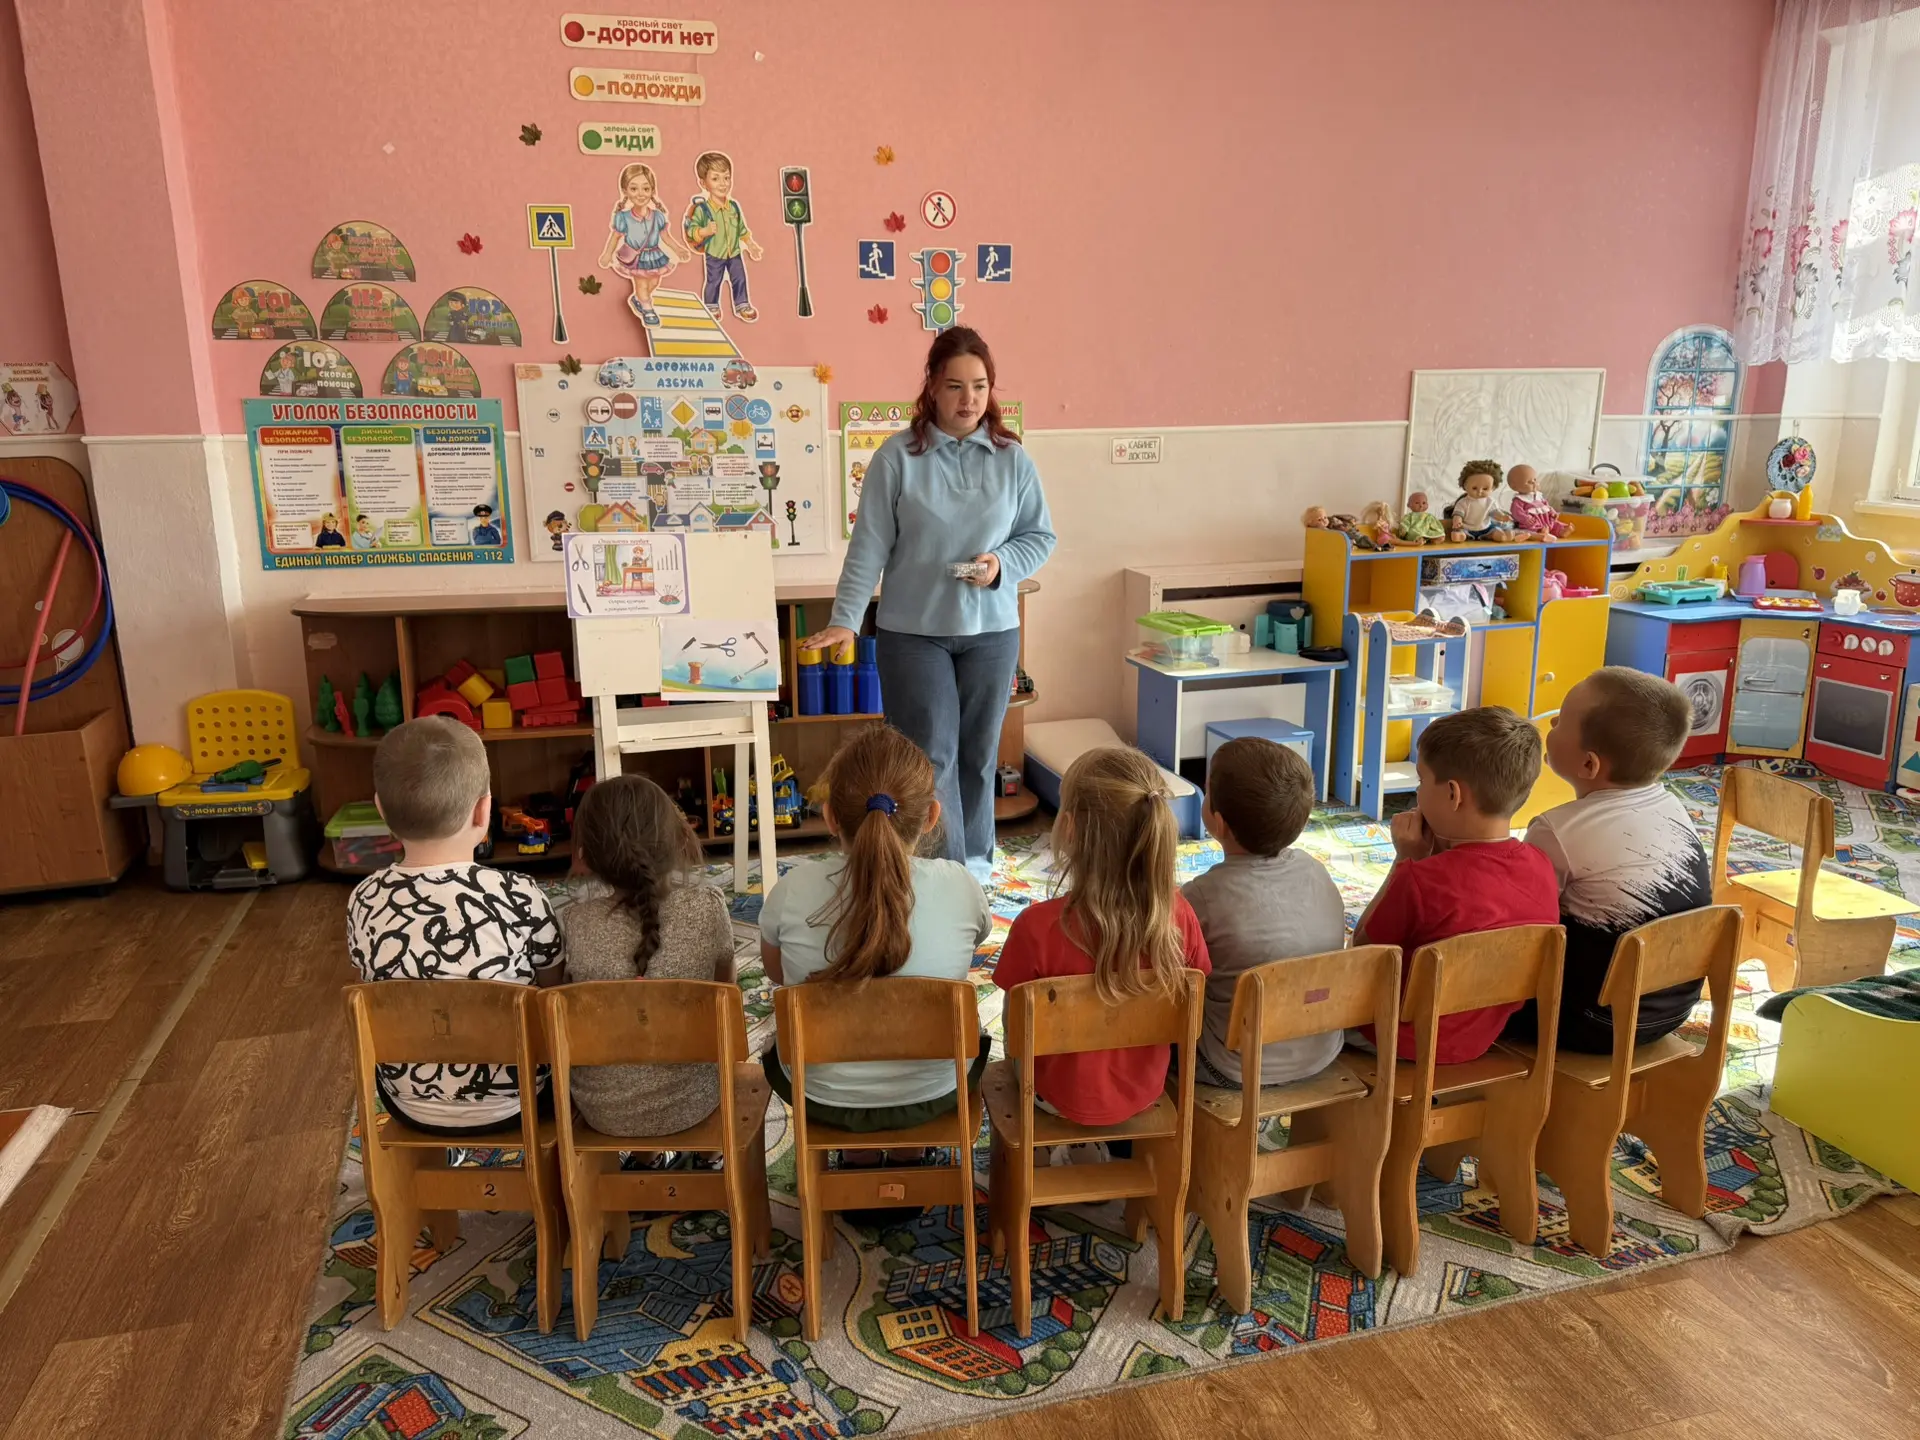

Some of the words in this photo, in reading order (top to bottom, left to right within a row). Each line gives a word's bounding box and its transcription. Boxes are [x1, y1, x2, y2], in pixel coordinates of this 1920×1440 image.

[617, 19, 658, 28] красный
[680, 31, 715, 46] нет
[623, 72, 661, 81] желтый
[258, 291, 291, 309] 101
[350, 287, 383, 307] 112
[469, 298, 502, 316] 102
[303, 351, 338, 369] 103
[644, 361, 715, 372] ДОРОЖНАЯ
[317, 380, 356, 389] ПОМОЩЬ
[657, 377, 704, 388] АЗБУКА
[272, 403, 340, 420] УГОЛОК
[345, 403, 479, 420] БЕЗОПАСНОСТИ
[449, 435, 479, 443] ДОРОГЕ
[1128, 440, 1157, 449] КАБИНЕТ
[1128, 452, 1157, 461] ДОКТОРА
[275, 554, 322, 568] ЕДИНЫЙ
[325, 554, 363, 566] НОМЕР
[367, 551, 416, 565] СЛУЖБЫ
[419, 551, 474, 563] СПАСЕНИЯ
[484, 550, 503, 561] 112
[484, 1183, 497, 1197] 2
[668, 1187, 676, 1197] 2
